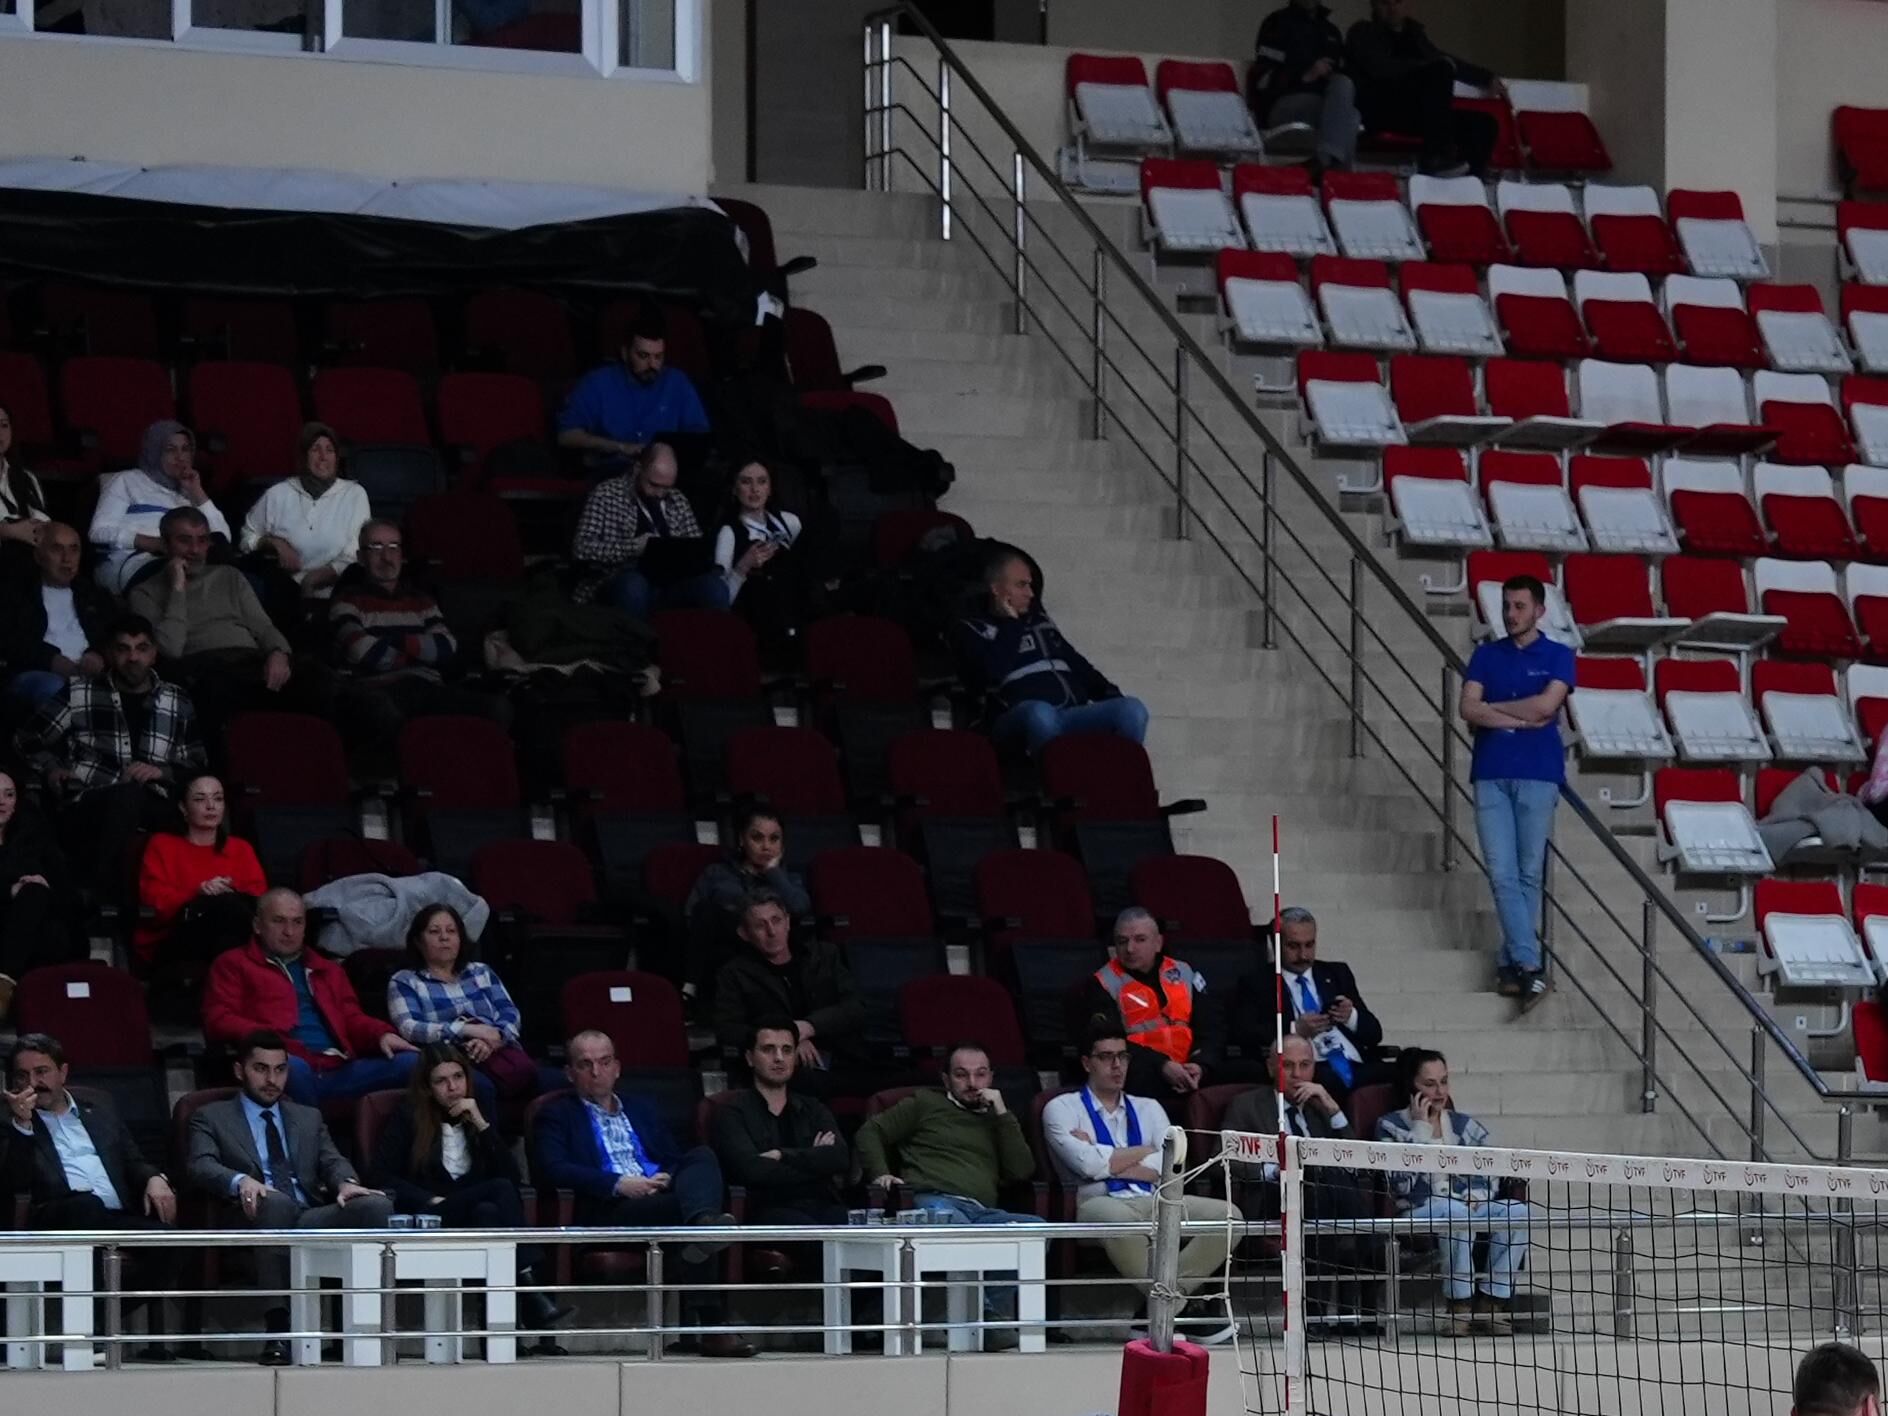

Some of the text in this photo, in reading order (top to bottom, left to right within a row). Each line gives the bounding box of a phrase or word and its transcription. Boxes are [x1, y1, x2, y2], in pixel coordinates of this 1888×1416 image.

[1240, 1136, 1260, 1154] TVF
[1411, 1154, 1423, 1163] TVF
[1447, 1156, 1458, 1165] TVF
[1482, 1157, 1493, 1167] TVF
[1519, 1159, 1532, 1169] TVF
[1557, 1161, 1569, 1171] TVF
[1596, 1164, 1608, 1174] TVF
[1633, 1166, 1645, 1176] TVF
[1673, 1169, 1686, 1178] TVF
[1713, 1172, 1727, 1181] TVF
[1754, 1173, 1767, 1183] TVF
[1795, 1175, 1808, 1185] TVF
[1838, 1179, 1852, 1188] TVF
